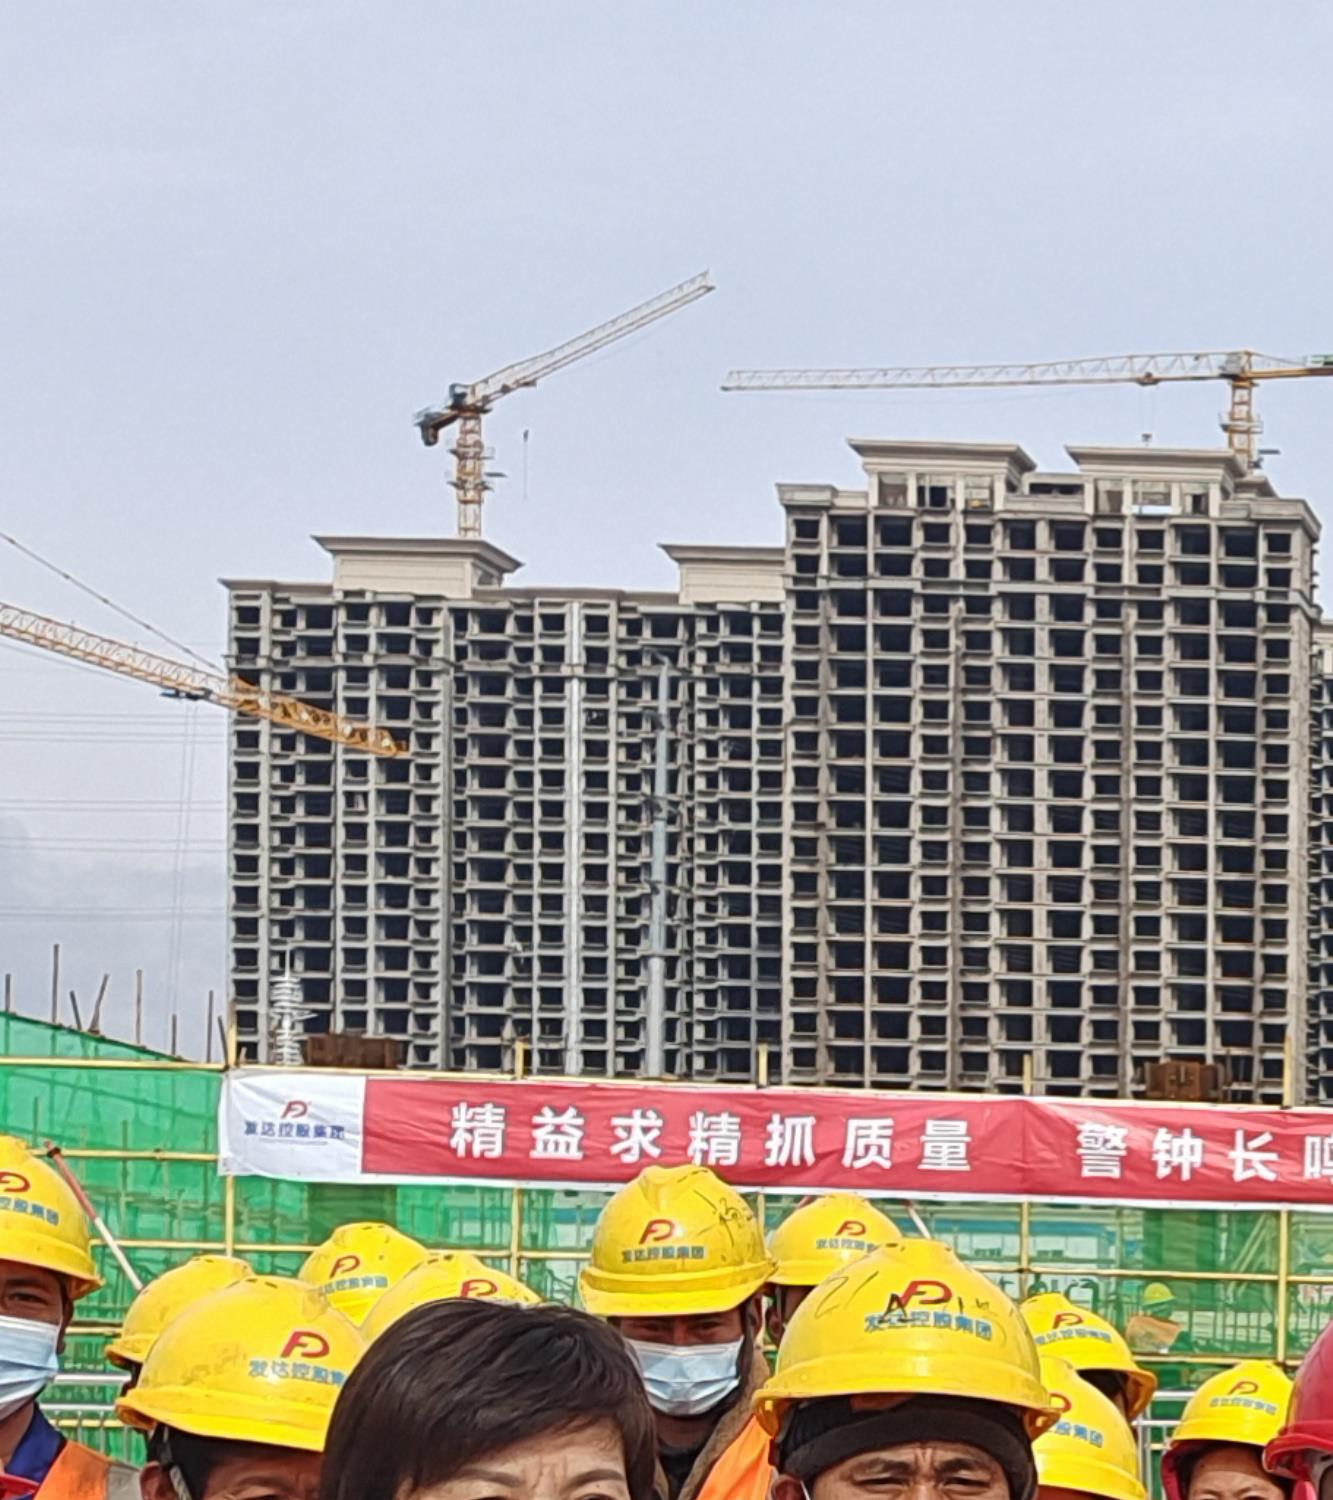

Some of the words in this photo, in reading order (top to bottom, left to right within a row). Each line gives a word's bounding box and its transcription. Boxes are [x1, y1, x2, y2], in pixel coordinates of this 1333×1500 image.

[450, 1102, 972, 1172] 精益求精抓质量
